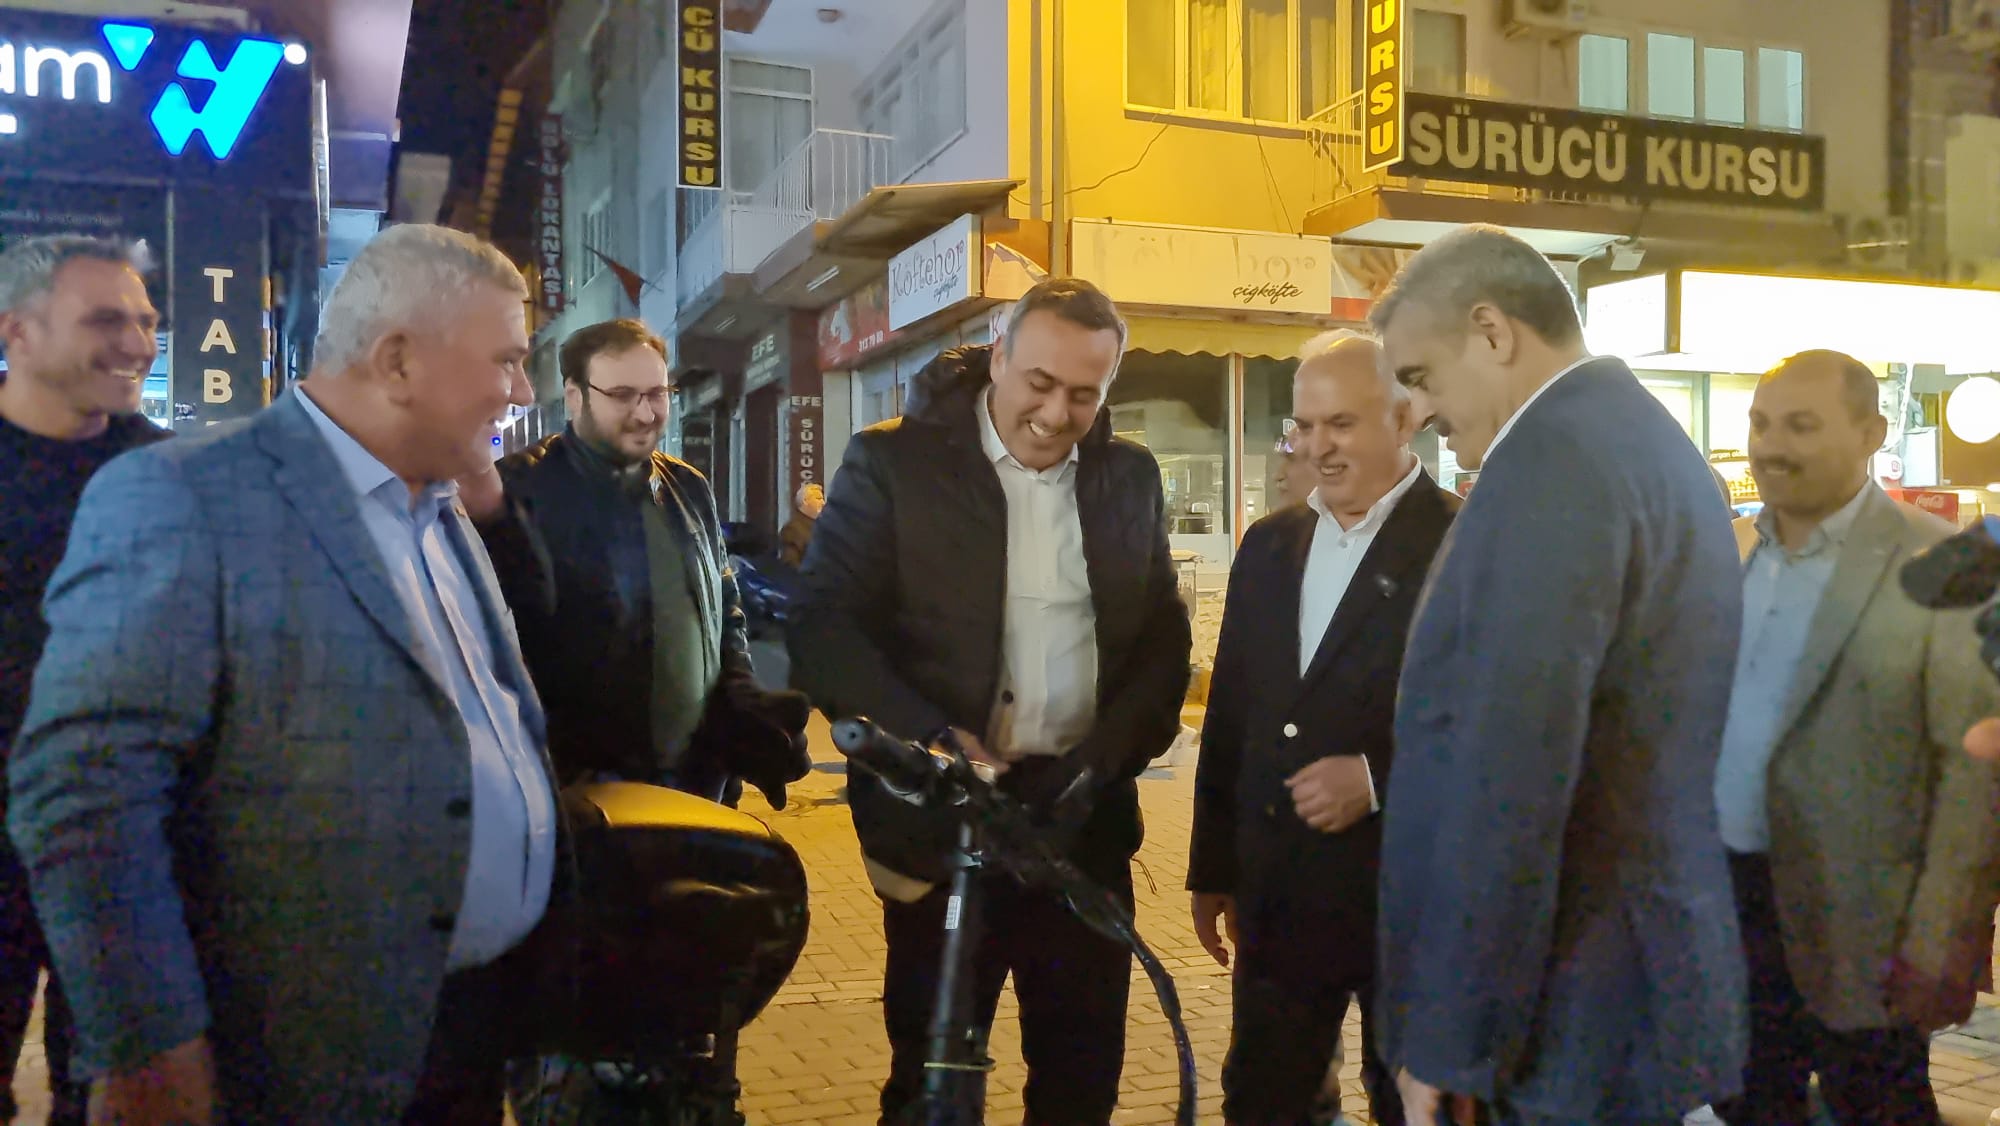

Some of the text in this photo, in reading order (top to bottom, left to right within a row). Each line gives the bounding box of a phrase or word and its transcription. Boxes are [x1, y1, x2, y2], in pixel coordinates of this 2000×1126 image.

[683, 67, 715, 186] KURSU
[1370, 0, 1396, 156] URSU
[1409, 105, 1811, 199] SÜRÜCÜ KURSU
[542, 181, 561, 307] LOKANTASI
[200, 267, 237, 427] TAB
[752, 333, 775, 362] EFE
[791, 396, 822, 407] EFE
[800, 418, 814, 484] SÜRÜC
